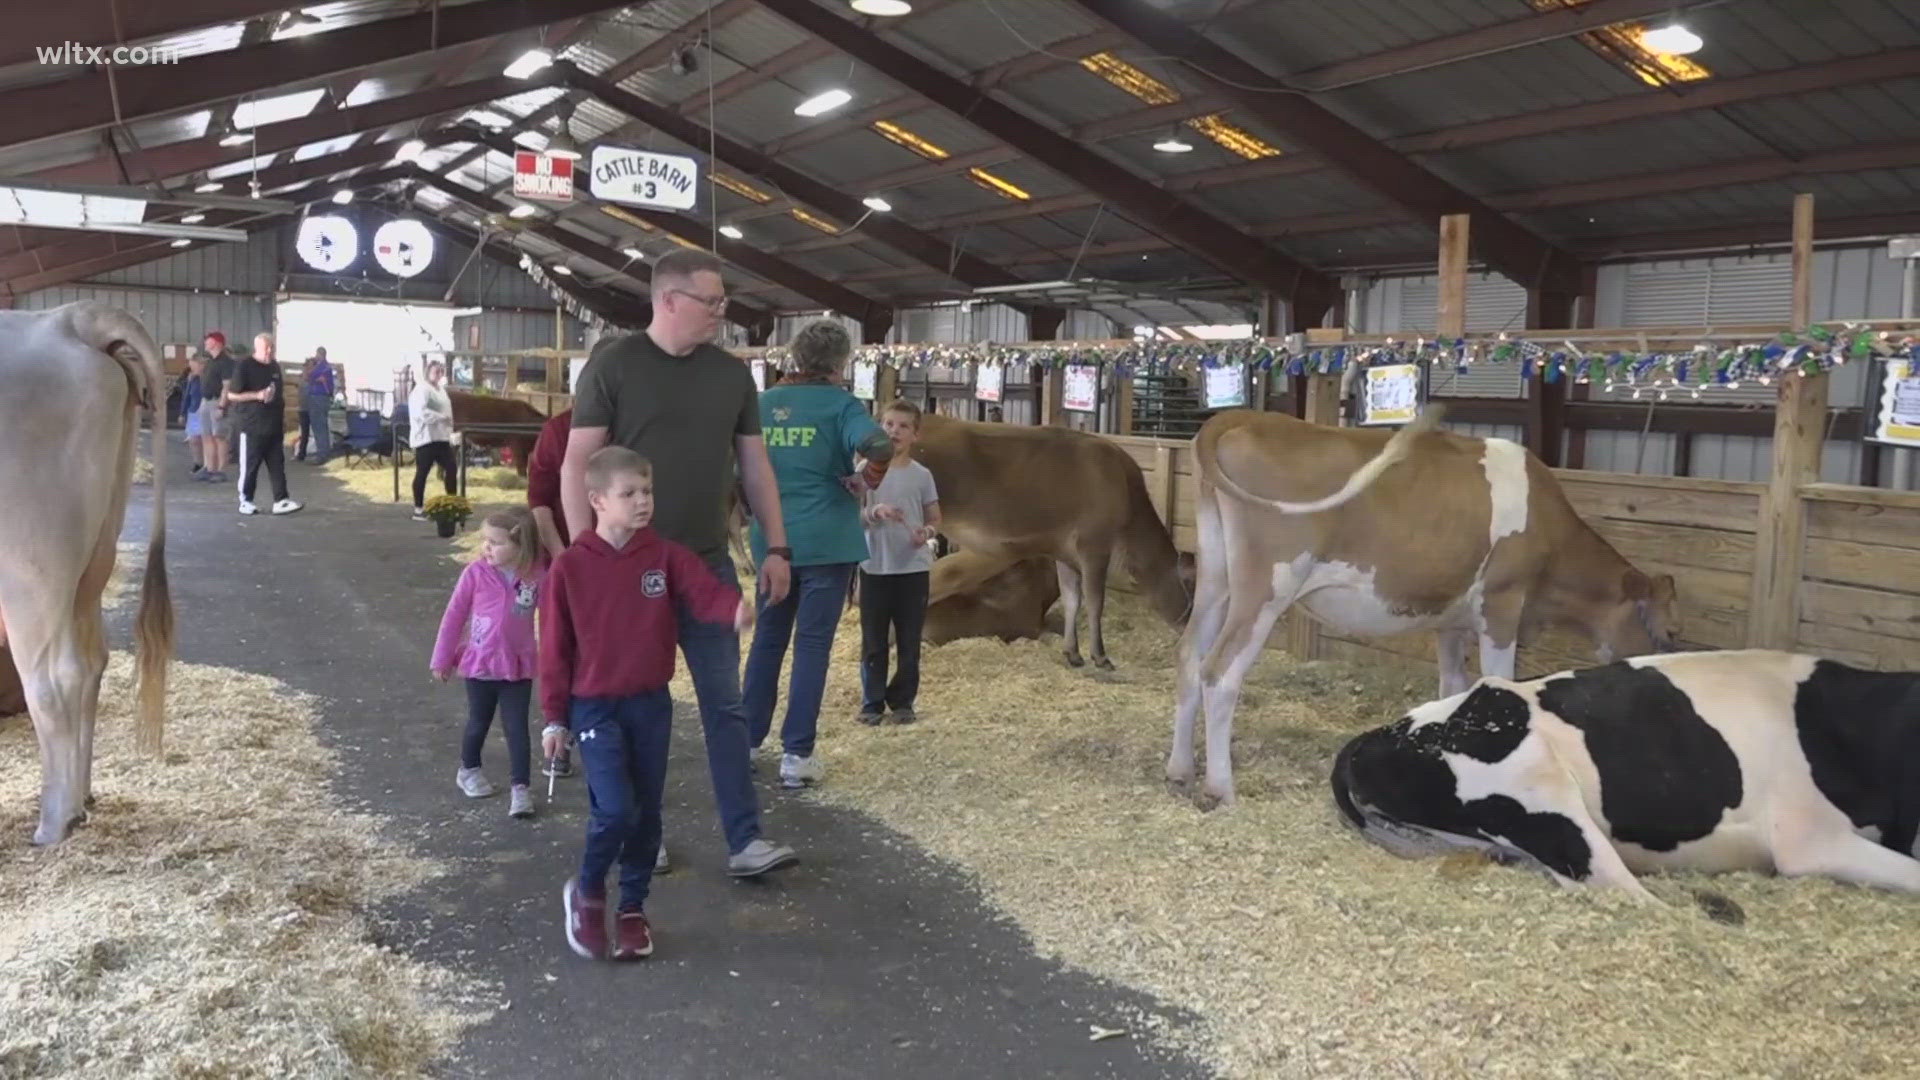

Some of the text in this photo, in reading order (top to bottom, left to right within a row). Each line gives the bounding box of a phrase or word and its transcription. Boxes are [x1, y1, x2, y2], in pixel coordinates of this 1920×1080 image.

[535, 156, 552, 174] NO
[515, 173, 571, 195] SMOKING
[595, 157, 692, 194] CATTLE BARN
[633, 182, 657, 199] #3
[762, 427, 817, 447] TAFF
